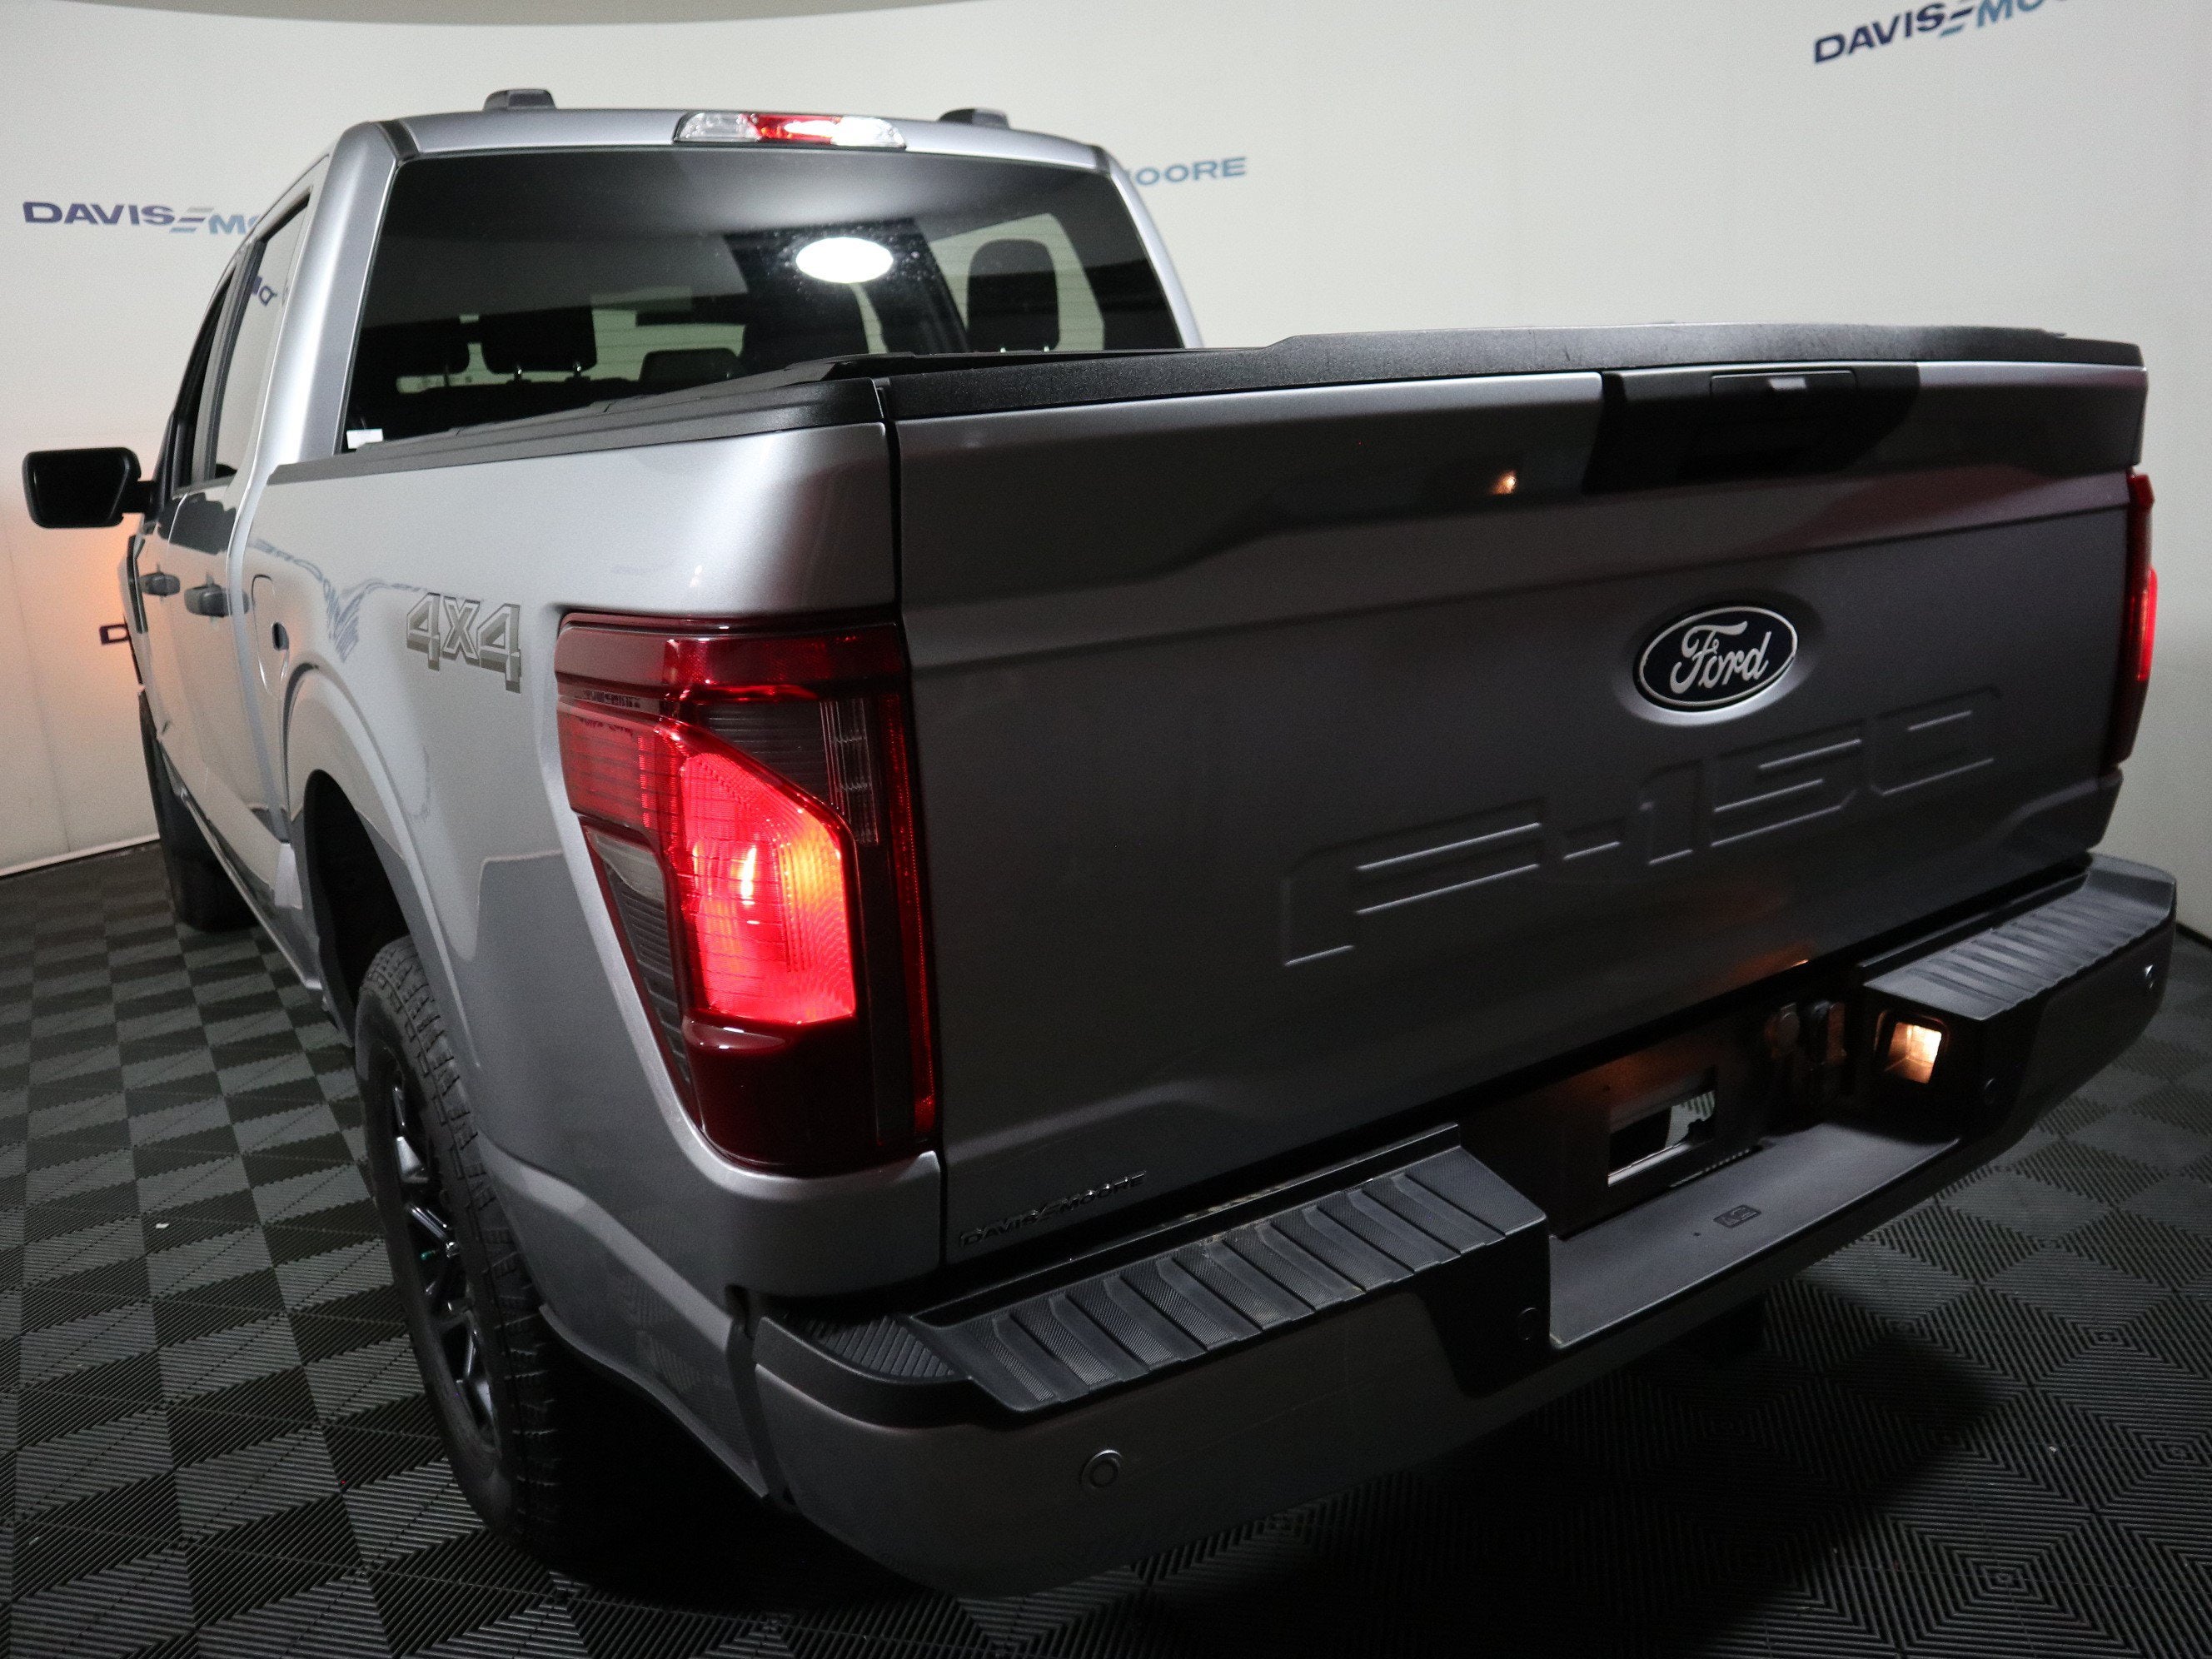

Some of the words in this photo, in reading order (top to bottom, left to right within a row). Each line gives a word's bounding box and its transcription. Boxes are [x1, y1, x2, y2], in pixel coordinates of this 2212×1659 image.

[1814, 2, 1945, 63] DAVIS
[22, 202, 175, 226] DAVIS
[1670, 620, 1772, 695] Ford
[1282, 686, 1998, 966] F-150
